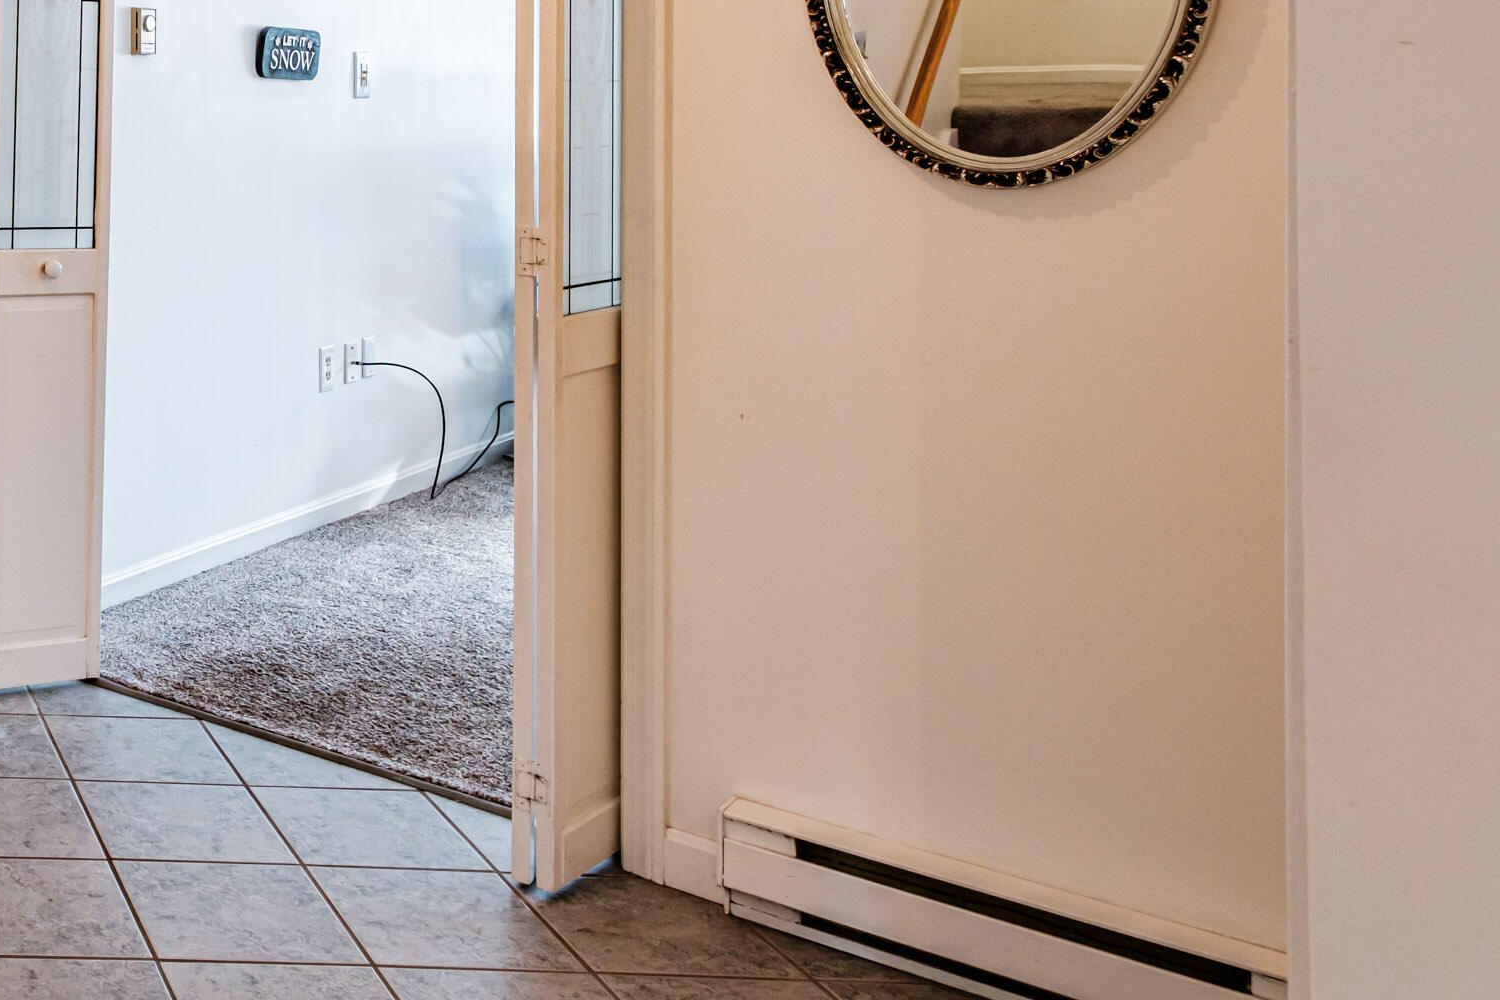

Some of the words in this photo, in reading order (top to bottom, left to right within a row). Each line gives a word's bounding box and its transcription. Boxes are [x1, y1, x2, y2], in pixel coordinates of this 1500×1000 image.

[283, 35, 297, 47] LET
[299, 36, 307, 47] IT
[270, 48, 315, 71] SNOW
